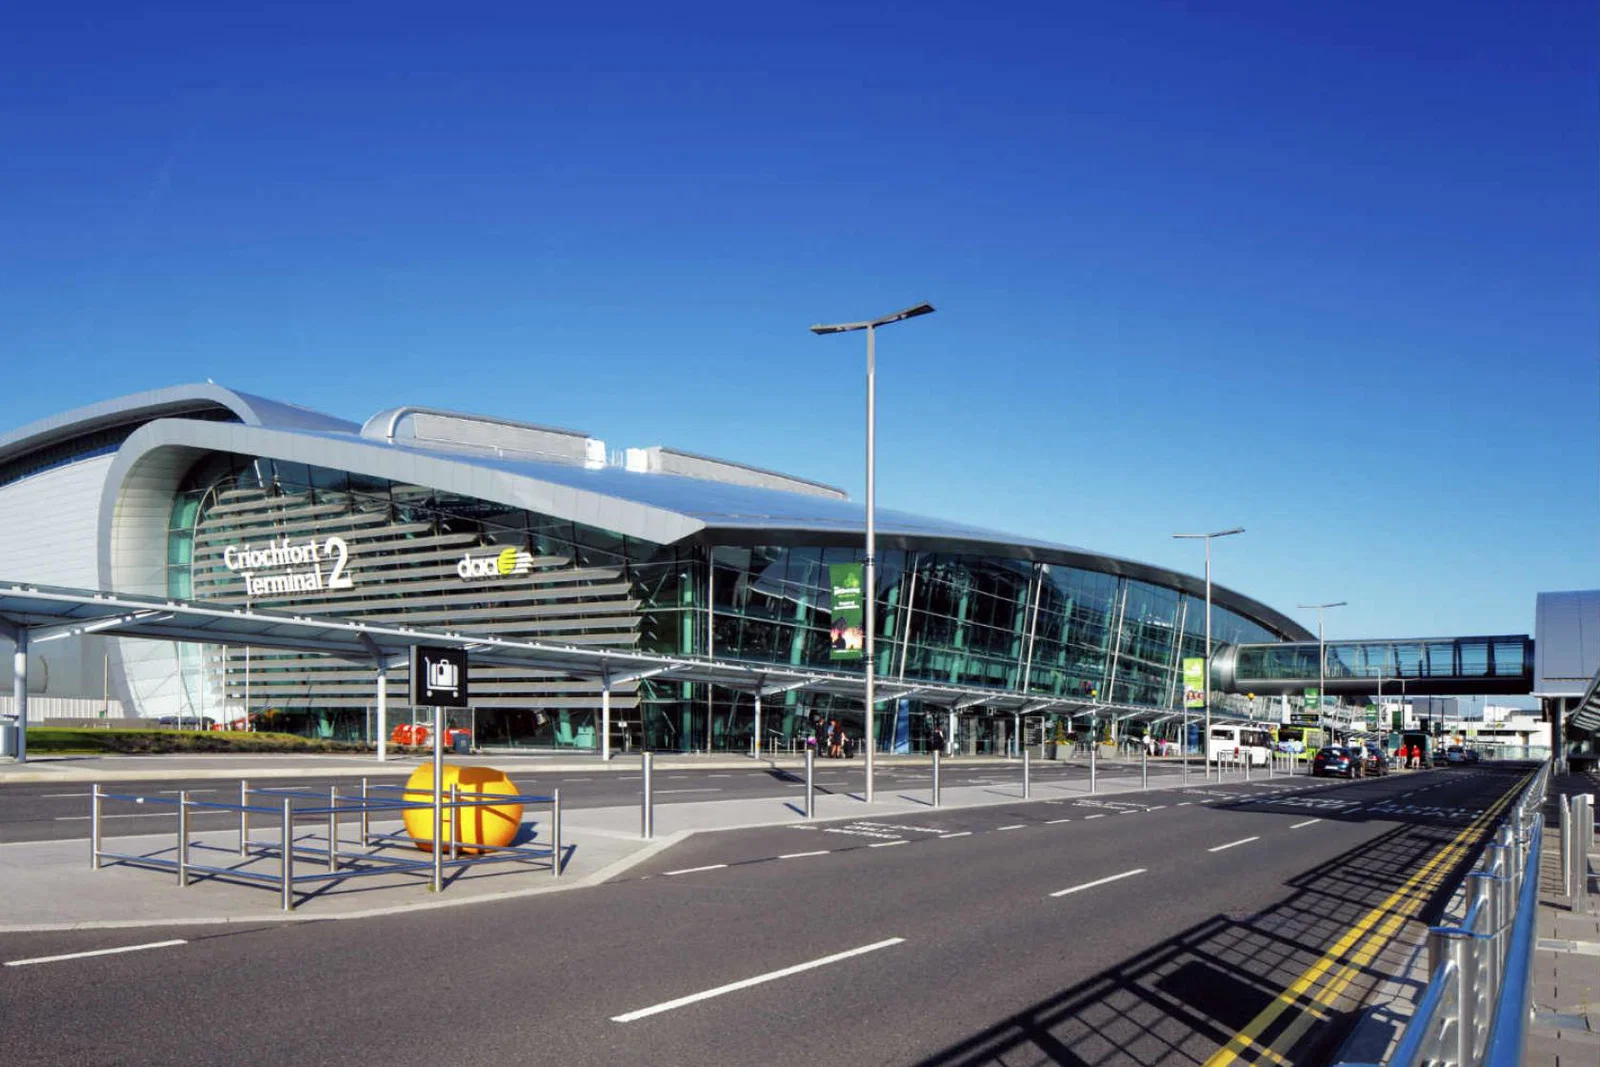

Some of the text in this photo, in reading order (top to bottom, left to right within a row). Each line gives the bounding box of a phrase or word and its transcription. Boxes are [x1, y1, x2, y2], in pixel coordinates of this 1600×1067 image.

[241, 536, 353, 595] Terminal 2
[457, 553, 501, 578] daa
